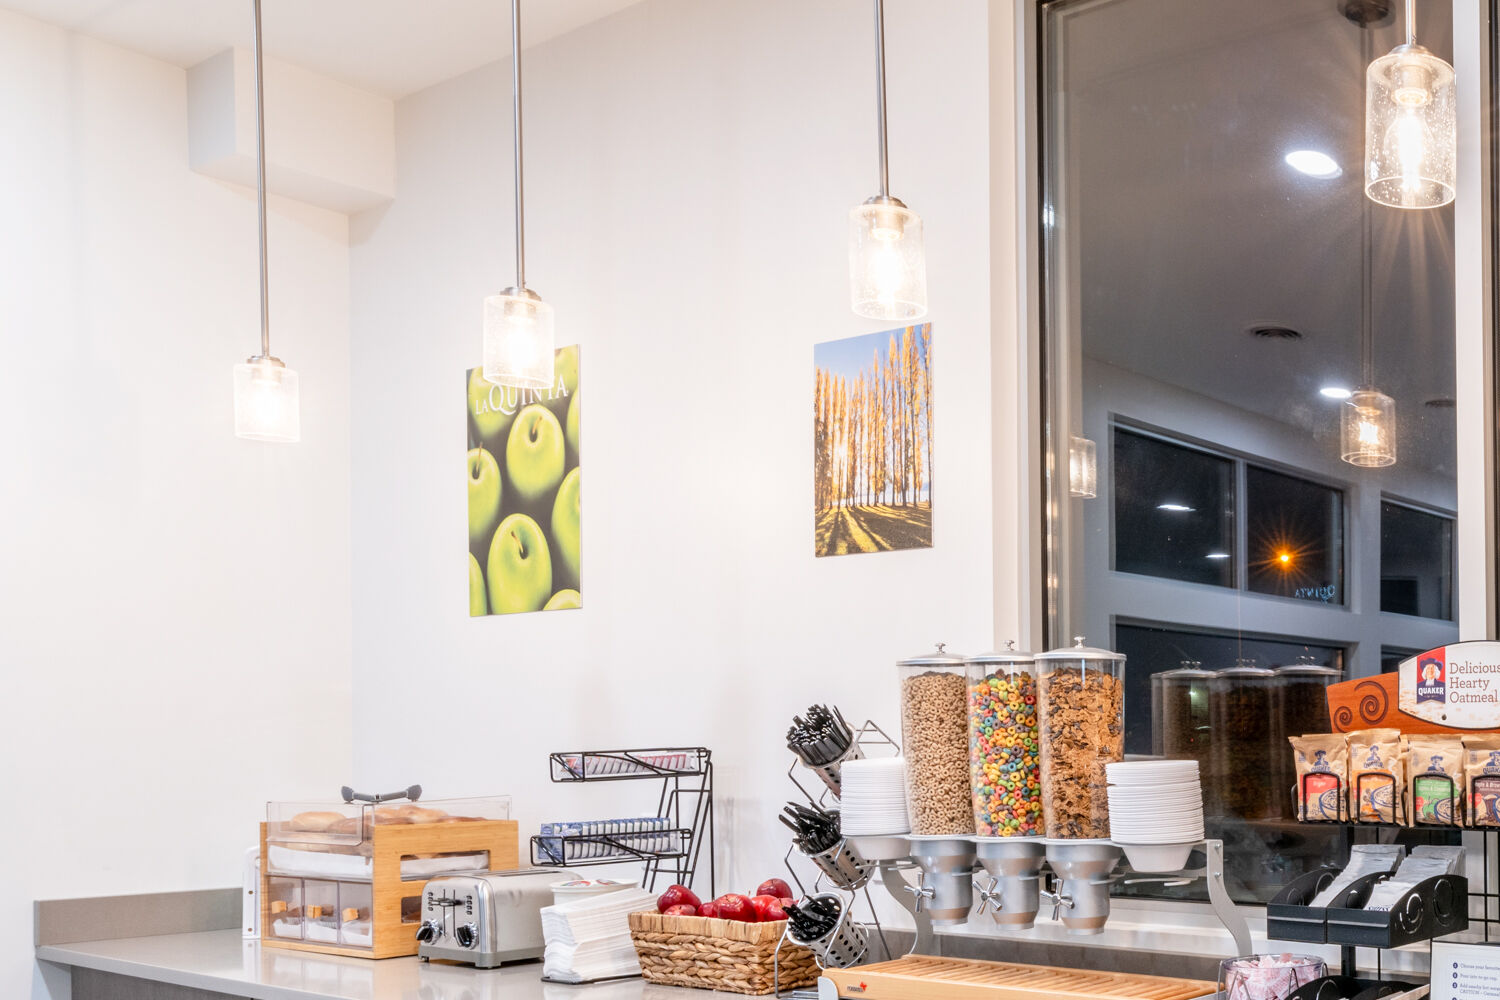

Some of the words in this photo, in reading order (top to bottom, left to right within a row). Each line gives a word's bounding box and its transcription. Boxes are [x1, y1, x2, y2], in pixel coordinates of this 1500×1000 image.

[475, 399, 489, 415] LA
[1449, 676, 1490, 691] Hearty
[1418, 687, 1444, 697] QUAKER
[1449, 689, 1498, 703] Oatmeal
